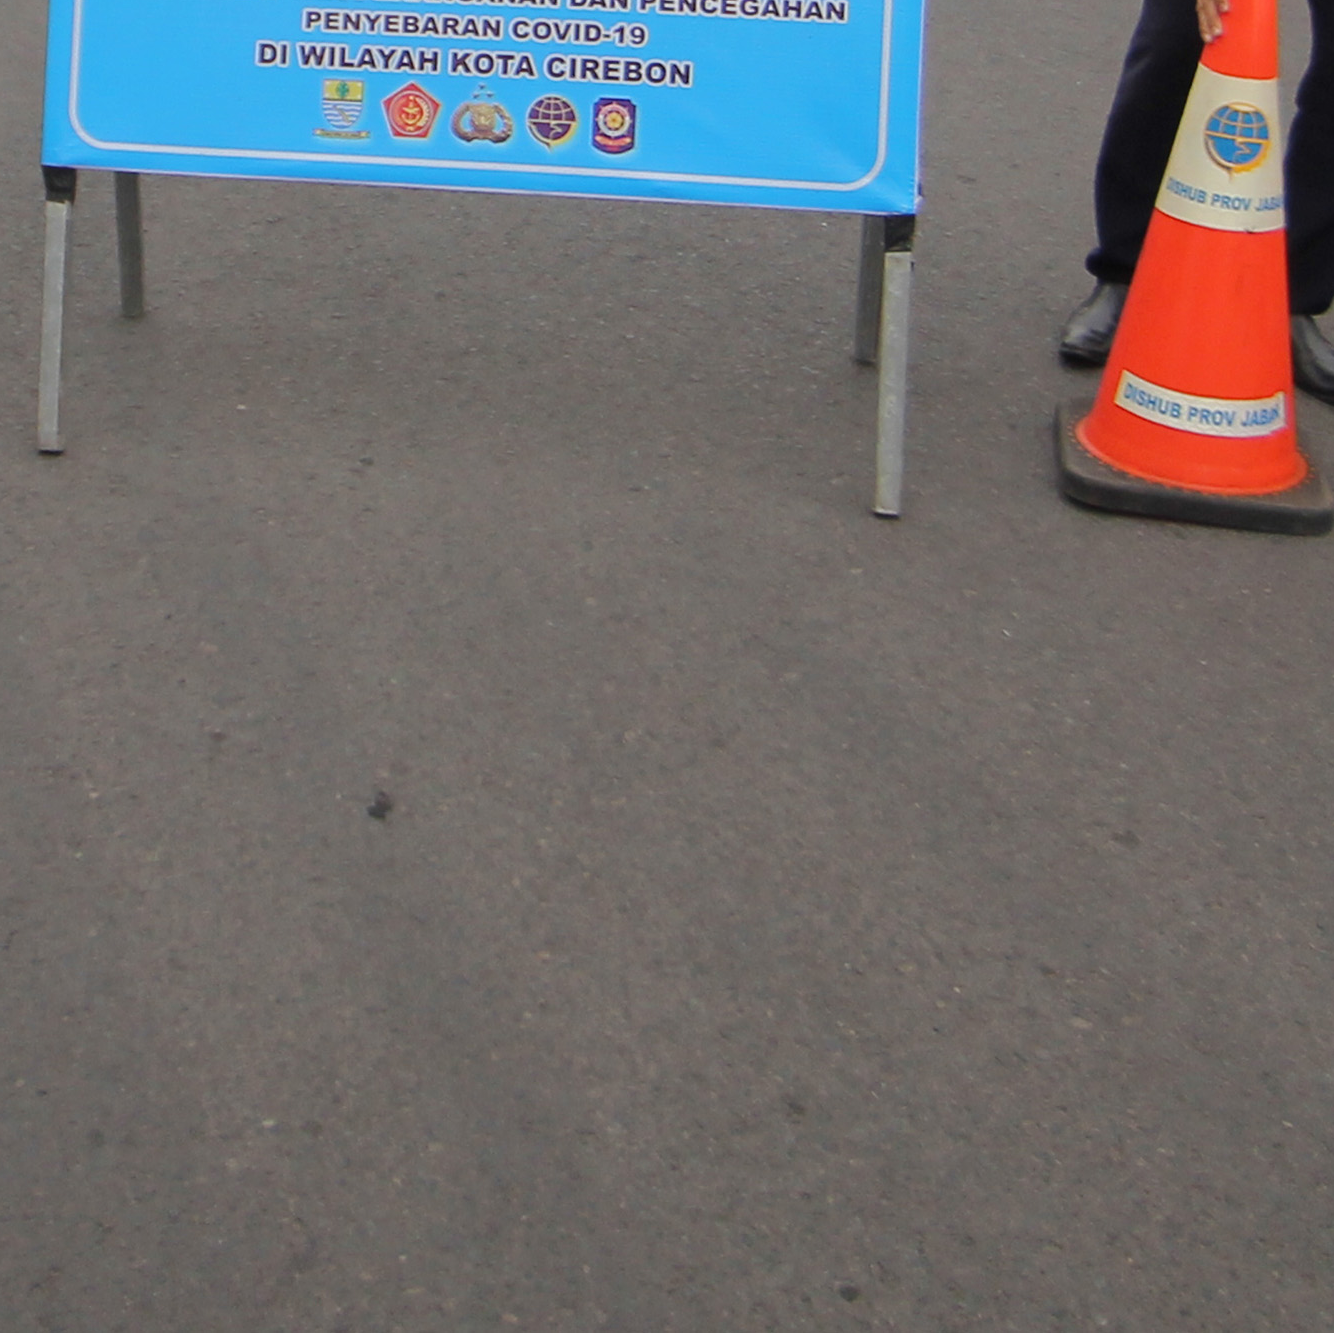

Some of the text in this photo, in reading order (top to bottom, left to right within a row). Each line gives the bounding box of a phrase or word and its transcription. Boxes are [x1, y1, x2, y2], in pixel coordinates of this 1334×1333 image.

[303, 10, 647, 45] PENYEBARAN COVID-19
[257, 43, 693, 86] DI WILAYAH KOTA CIREBON
[1166, 177, 1283, 212] DISHUB PROV JABA
[1123, 382, 1181, 418] DISHUB
[1187, 405, 1236, 427] PROV
